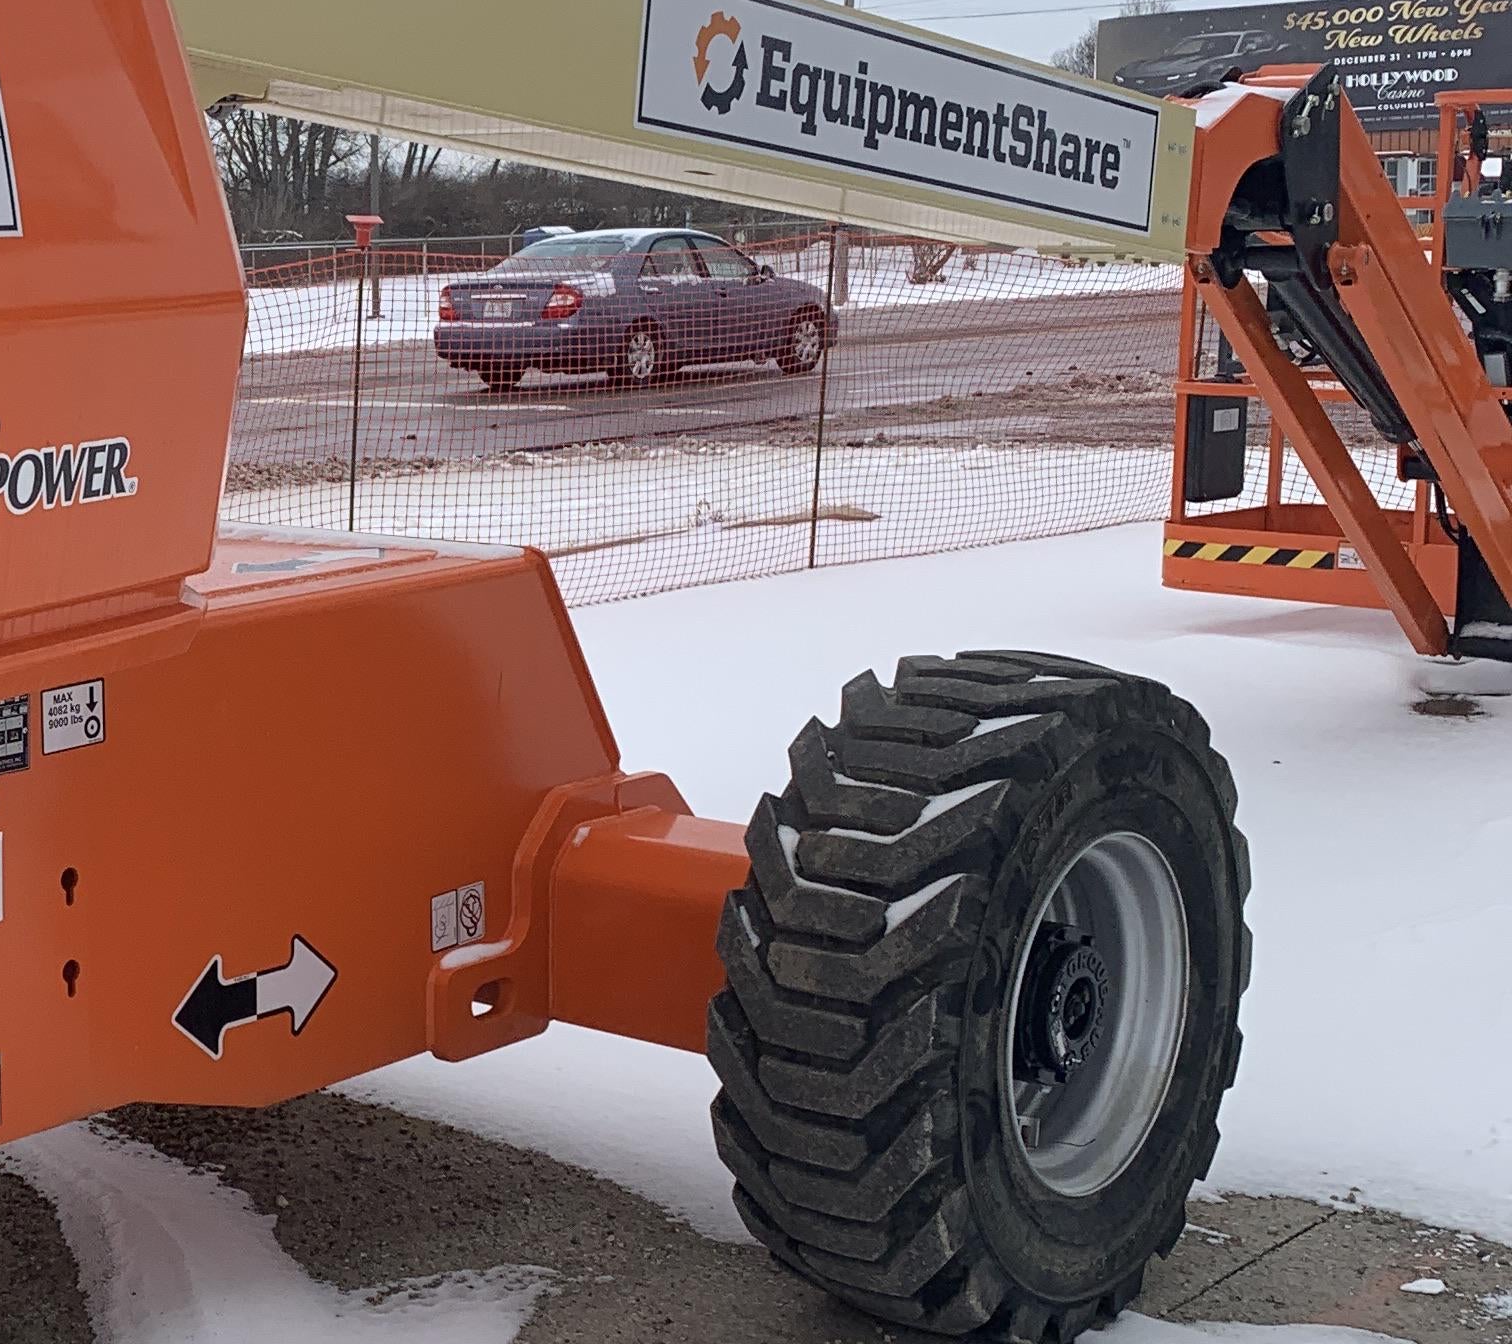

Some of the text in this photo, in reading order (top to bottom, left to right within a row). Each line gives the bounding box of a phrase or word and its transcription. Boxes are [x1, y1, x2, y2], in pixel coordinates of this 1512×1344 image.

[1283, 5, 1384, 32] $45,000
[1323, 22, 1485, 51] New Wheels
[1334, 48, 1472, 66] DECEMBER 31 1PM 6PM
[1345, 68, 1459, 88] HOLLYWOOD
[1376, 84, 1426, 101] Casino
[1377, 102, 1425, 111] COLUMBUS
[53, 692, 73, 704] MAX
[48, 703, 81, 717] 4082 kg
[48, 715, 84, 730] 9000 lbs
